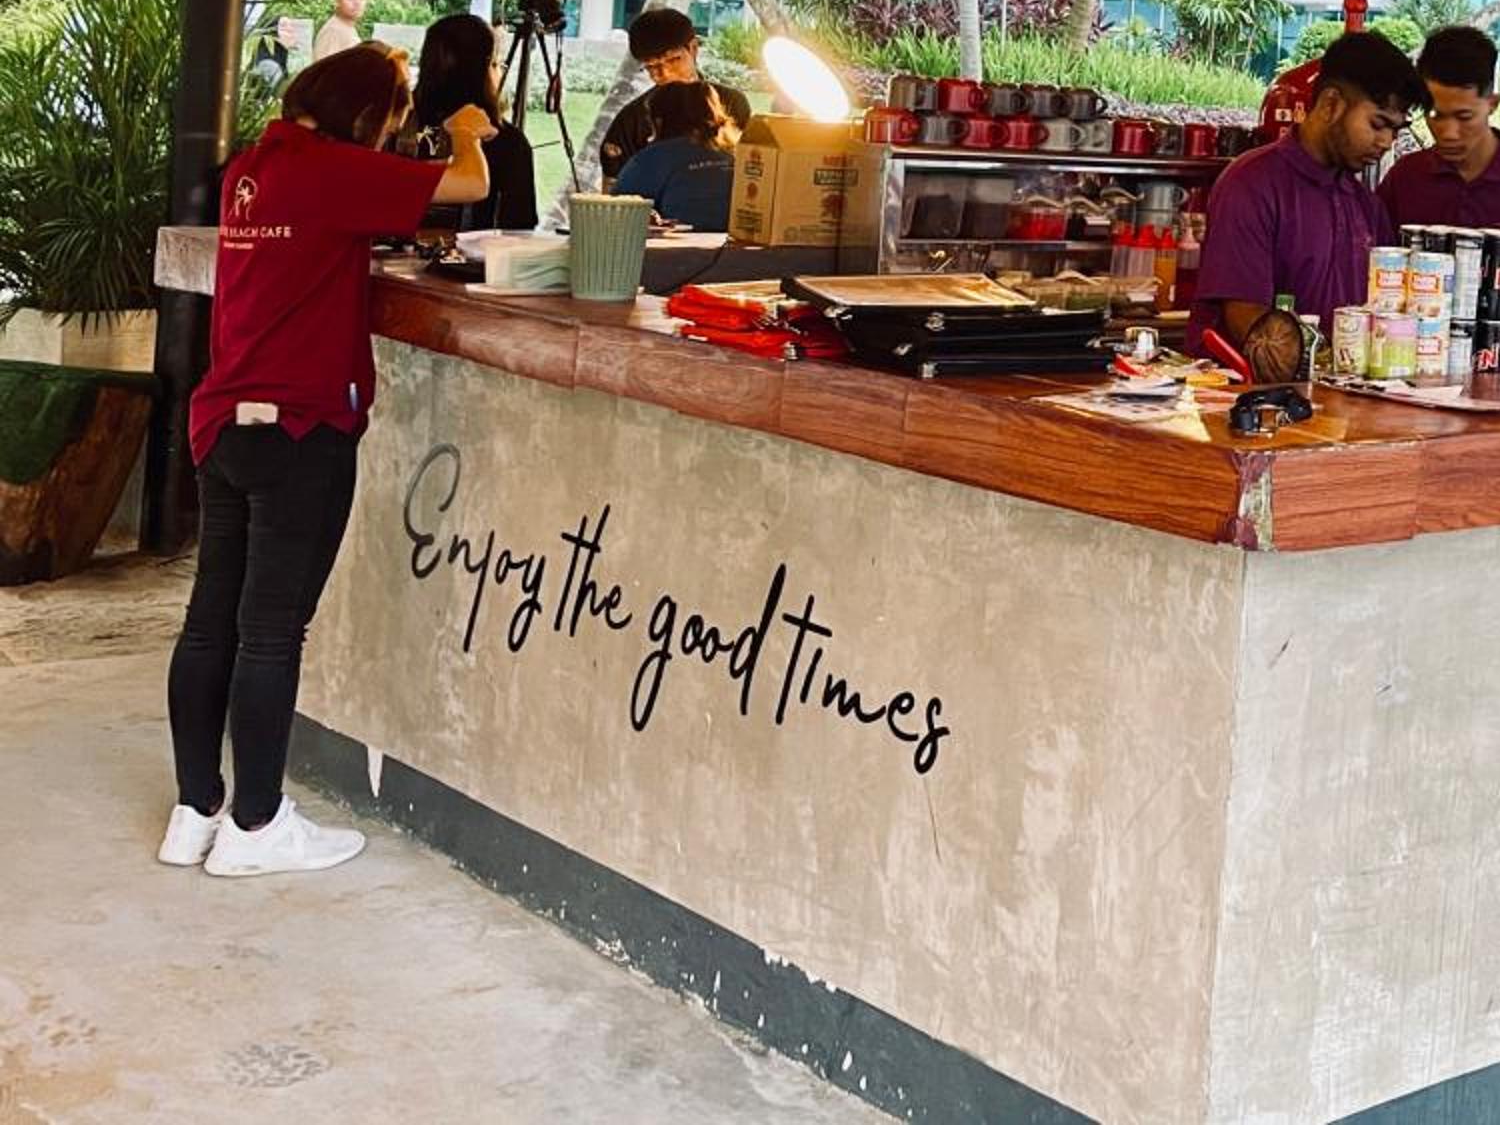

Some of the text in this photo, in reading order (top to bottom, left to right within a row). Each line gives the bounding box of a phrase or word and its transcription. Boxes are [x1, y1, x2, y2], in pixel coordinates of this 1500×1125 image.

[403, 443, 950, 774] Enjoy the good times
